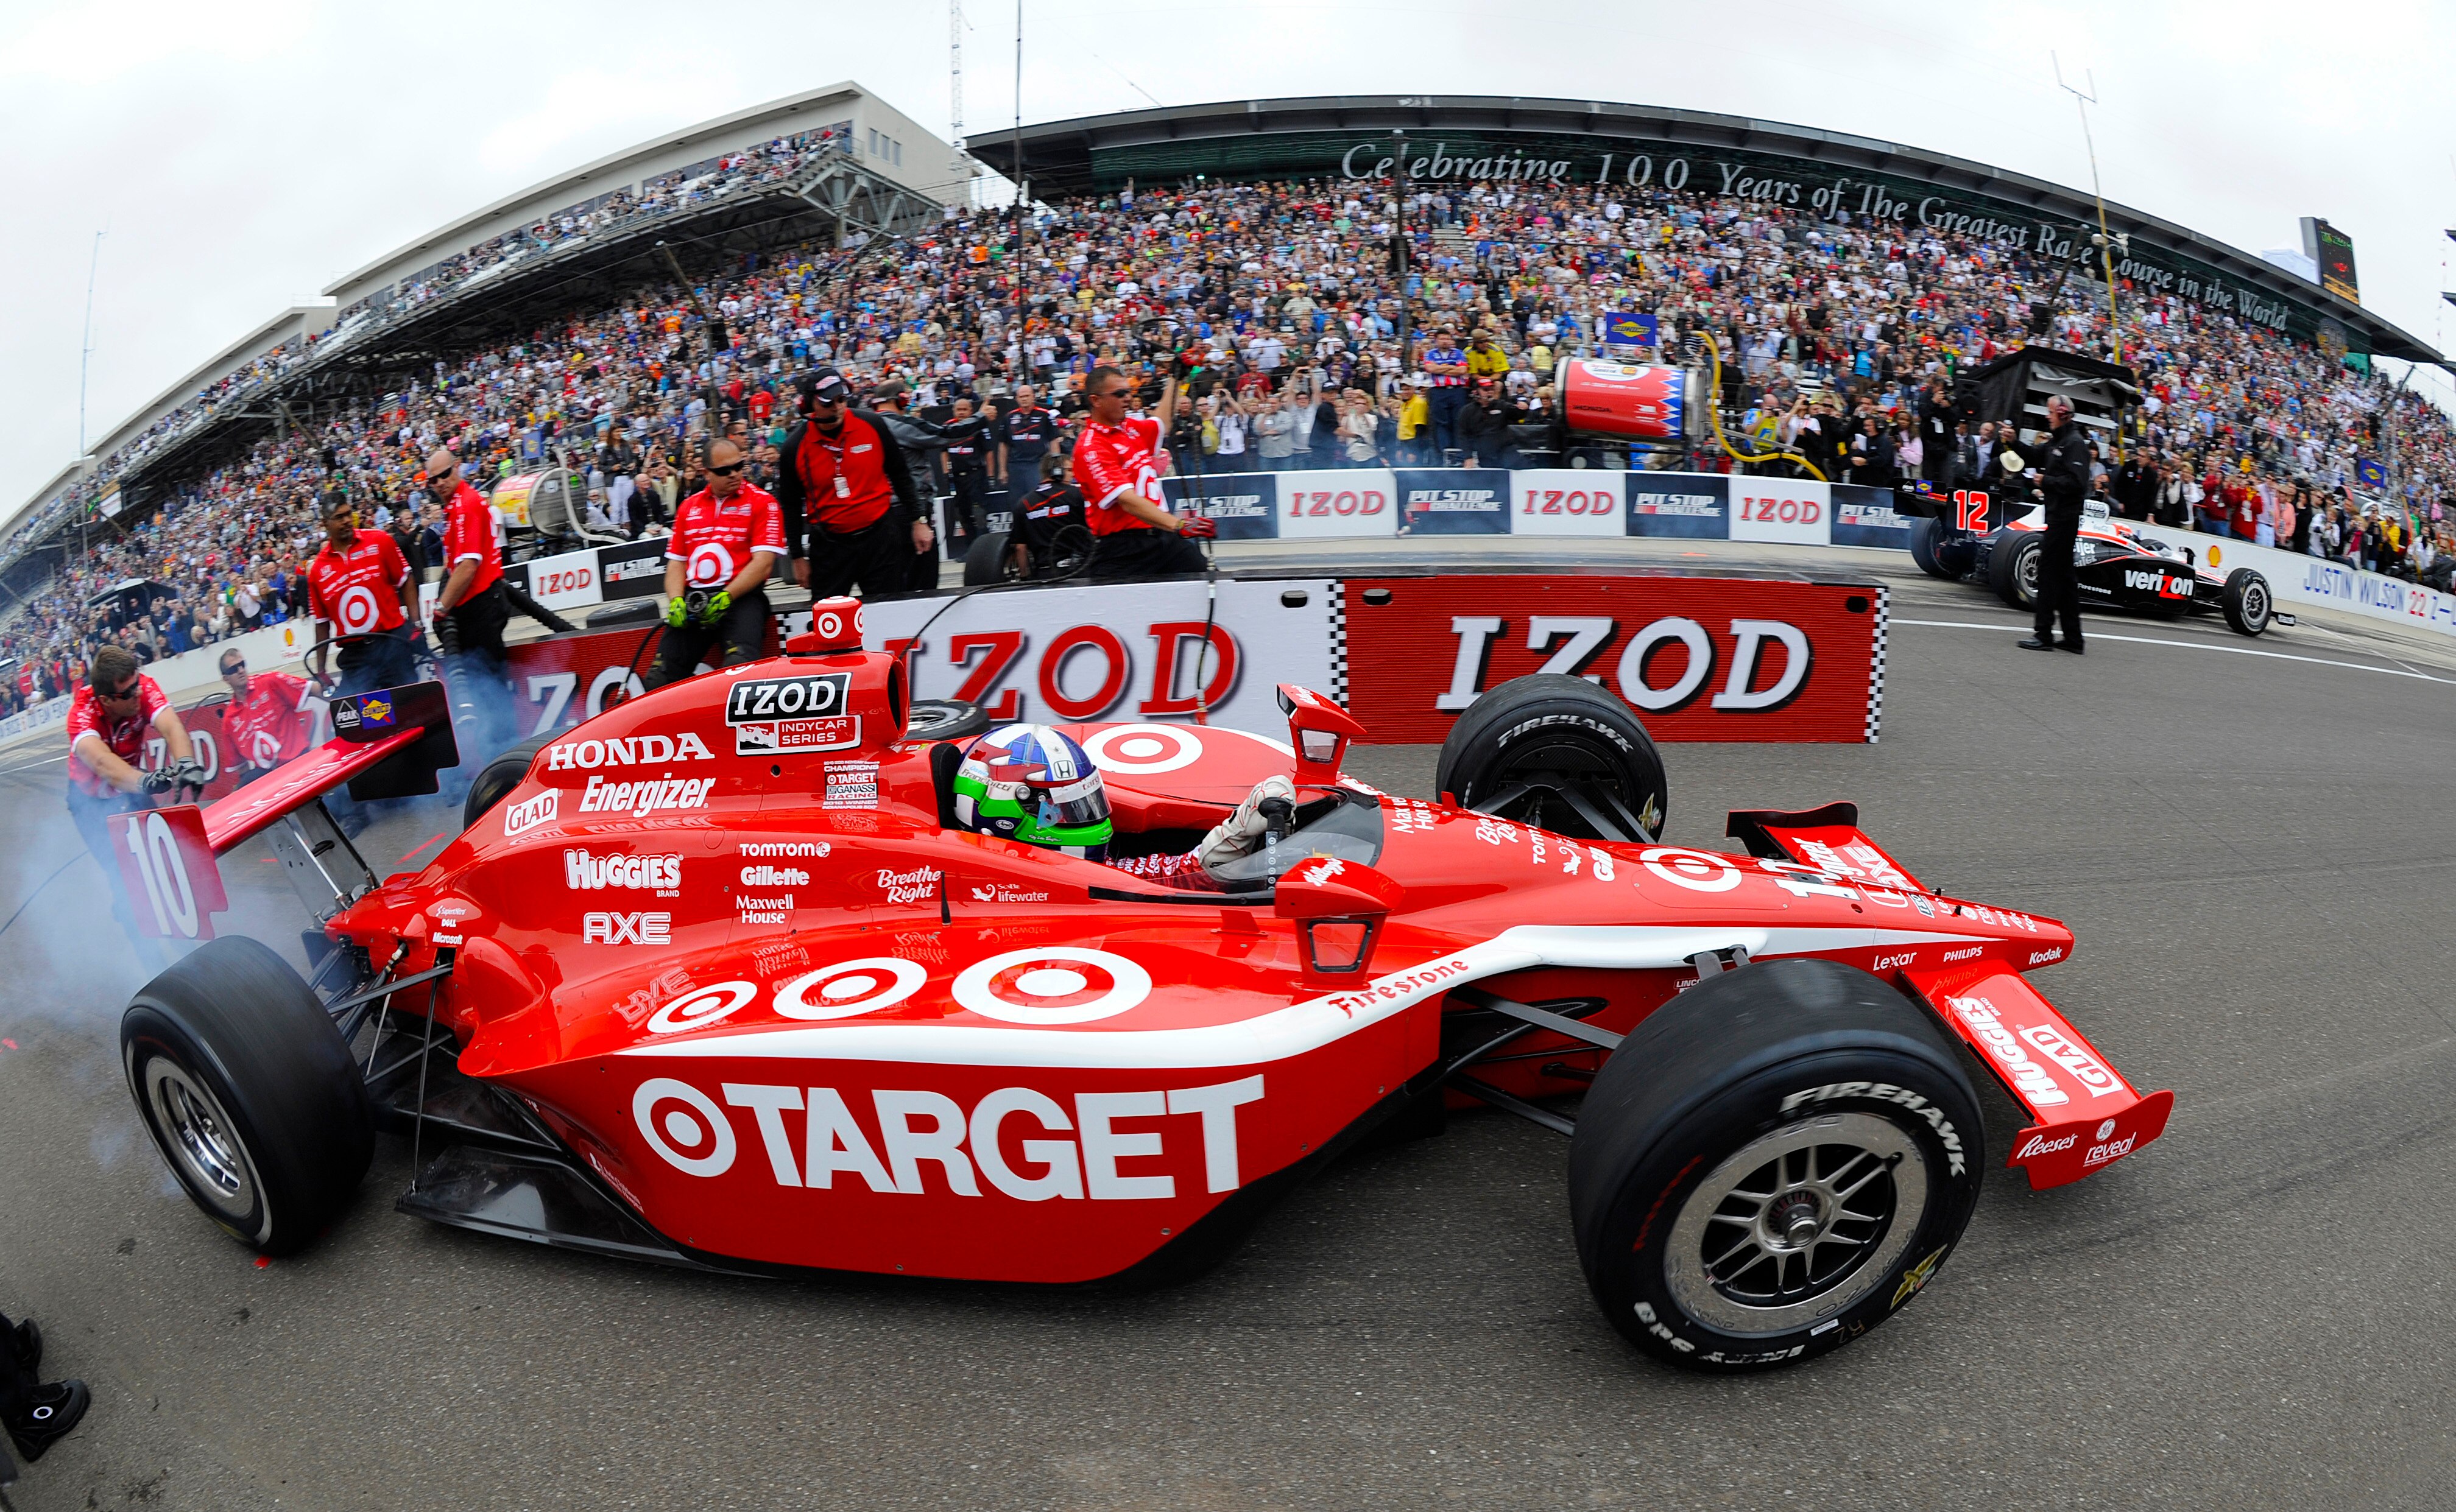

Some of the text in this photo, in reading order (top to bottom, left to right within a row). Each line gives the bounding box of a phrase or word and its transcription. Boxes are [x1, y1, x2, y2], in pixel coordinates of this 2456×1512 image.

[1341, 142, 1571, 183] Celebrating
[1717, 163, 1802, 205] Years
[1812, 178, 1851, 220] of
[1855, 183, 1910, 221] The
[1918, 197, 2030, 248] Greatest
[2178, 269, 2200, 298] in
[2204, 278, 2234, 310] the
[2237, 288, 2288, 331] World
[1209, 494, 1261, 507] STOP
[1290, 490, 1386, 517] IZOD
[1408, 490, 1495, 503] PIT STOP
[1523, 490, 1614, 515] IZOD
[1636, 493, 1716, 508] PIT STOP
[1740, 497, 1821, 524] IZOD
[1953, 489, 1989, 533] 12
[537, 568, 593, 597] IZOD
[2125, 568, 2194, 600] verizon
[2303, 563, 2354, 600] JUSTIN
[2358, 575, 2407, 613] WILSON
[2408, 590, 2427, 617] 22
[883, 620, 1240, 722] IZOD
[1434, 615, 1813, 711] IZOD
[734, 680, 836, 717] IZOD
[781, 718, 847, 733] INDYCAR
[782, 730, 836, 745] SERIES
[548, 732, 716, 772] HONDA
[836, 772, 876, 784] TARGET
[836, 784, 876, 793] GANASSI
[961, 768, 1014, 792] Franchitti
[578, 772, 717, 818] Energizer
[508, 793, 556, 834] GLAD
[125, 811, 200, 940] 10
[563, 848, 682, 890] HUGGIES
[740, 865, 810, 887] Gillette
[877, 865, 942, 888] Breathe
[656, 890, 680, 898] BRAND
[735, 893, 794, 912] Maxwell
[887, 883, 936, 904] Right
[998, 890, 1050, 903] lifewater
[441, 918, 457, 927] DELL
[583, 910, 671, 945] AXE
[741, 908, 786, 925] House
[432, 932, 464, 945] Microsoft
[1872, 951, 1917, 971] Lexar
[1943, 946, 1983, 963] PHILIPS
[2028, 946, 2063, 966] Kodak
[1327, 957, 1470, 1021] Firestone
[1980, 996, 2002, 1018] BRAND
[1948, 995, 2070, 1107] HUGGIES
[2030, 1029, 2114, 1090] GLAD
[719, 1073, 1266, 1201] TARGET
[1777, 1080, 1967, 1178] FIREHAWK
[2016, 1133, 2078, 1161] Reese's
[2084, 1131, 2137, 1162] reveal
